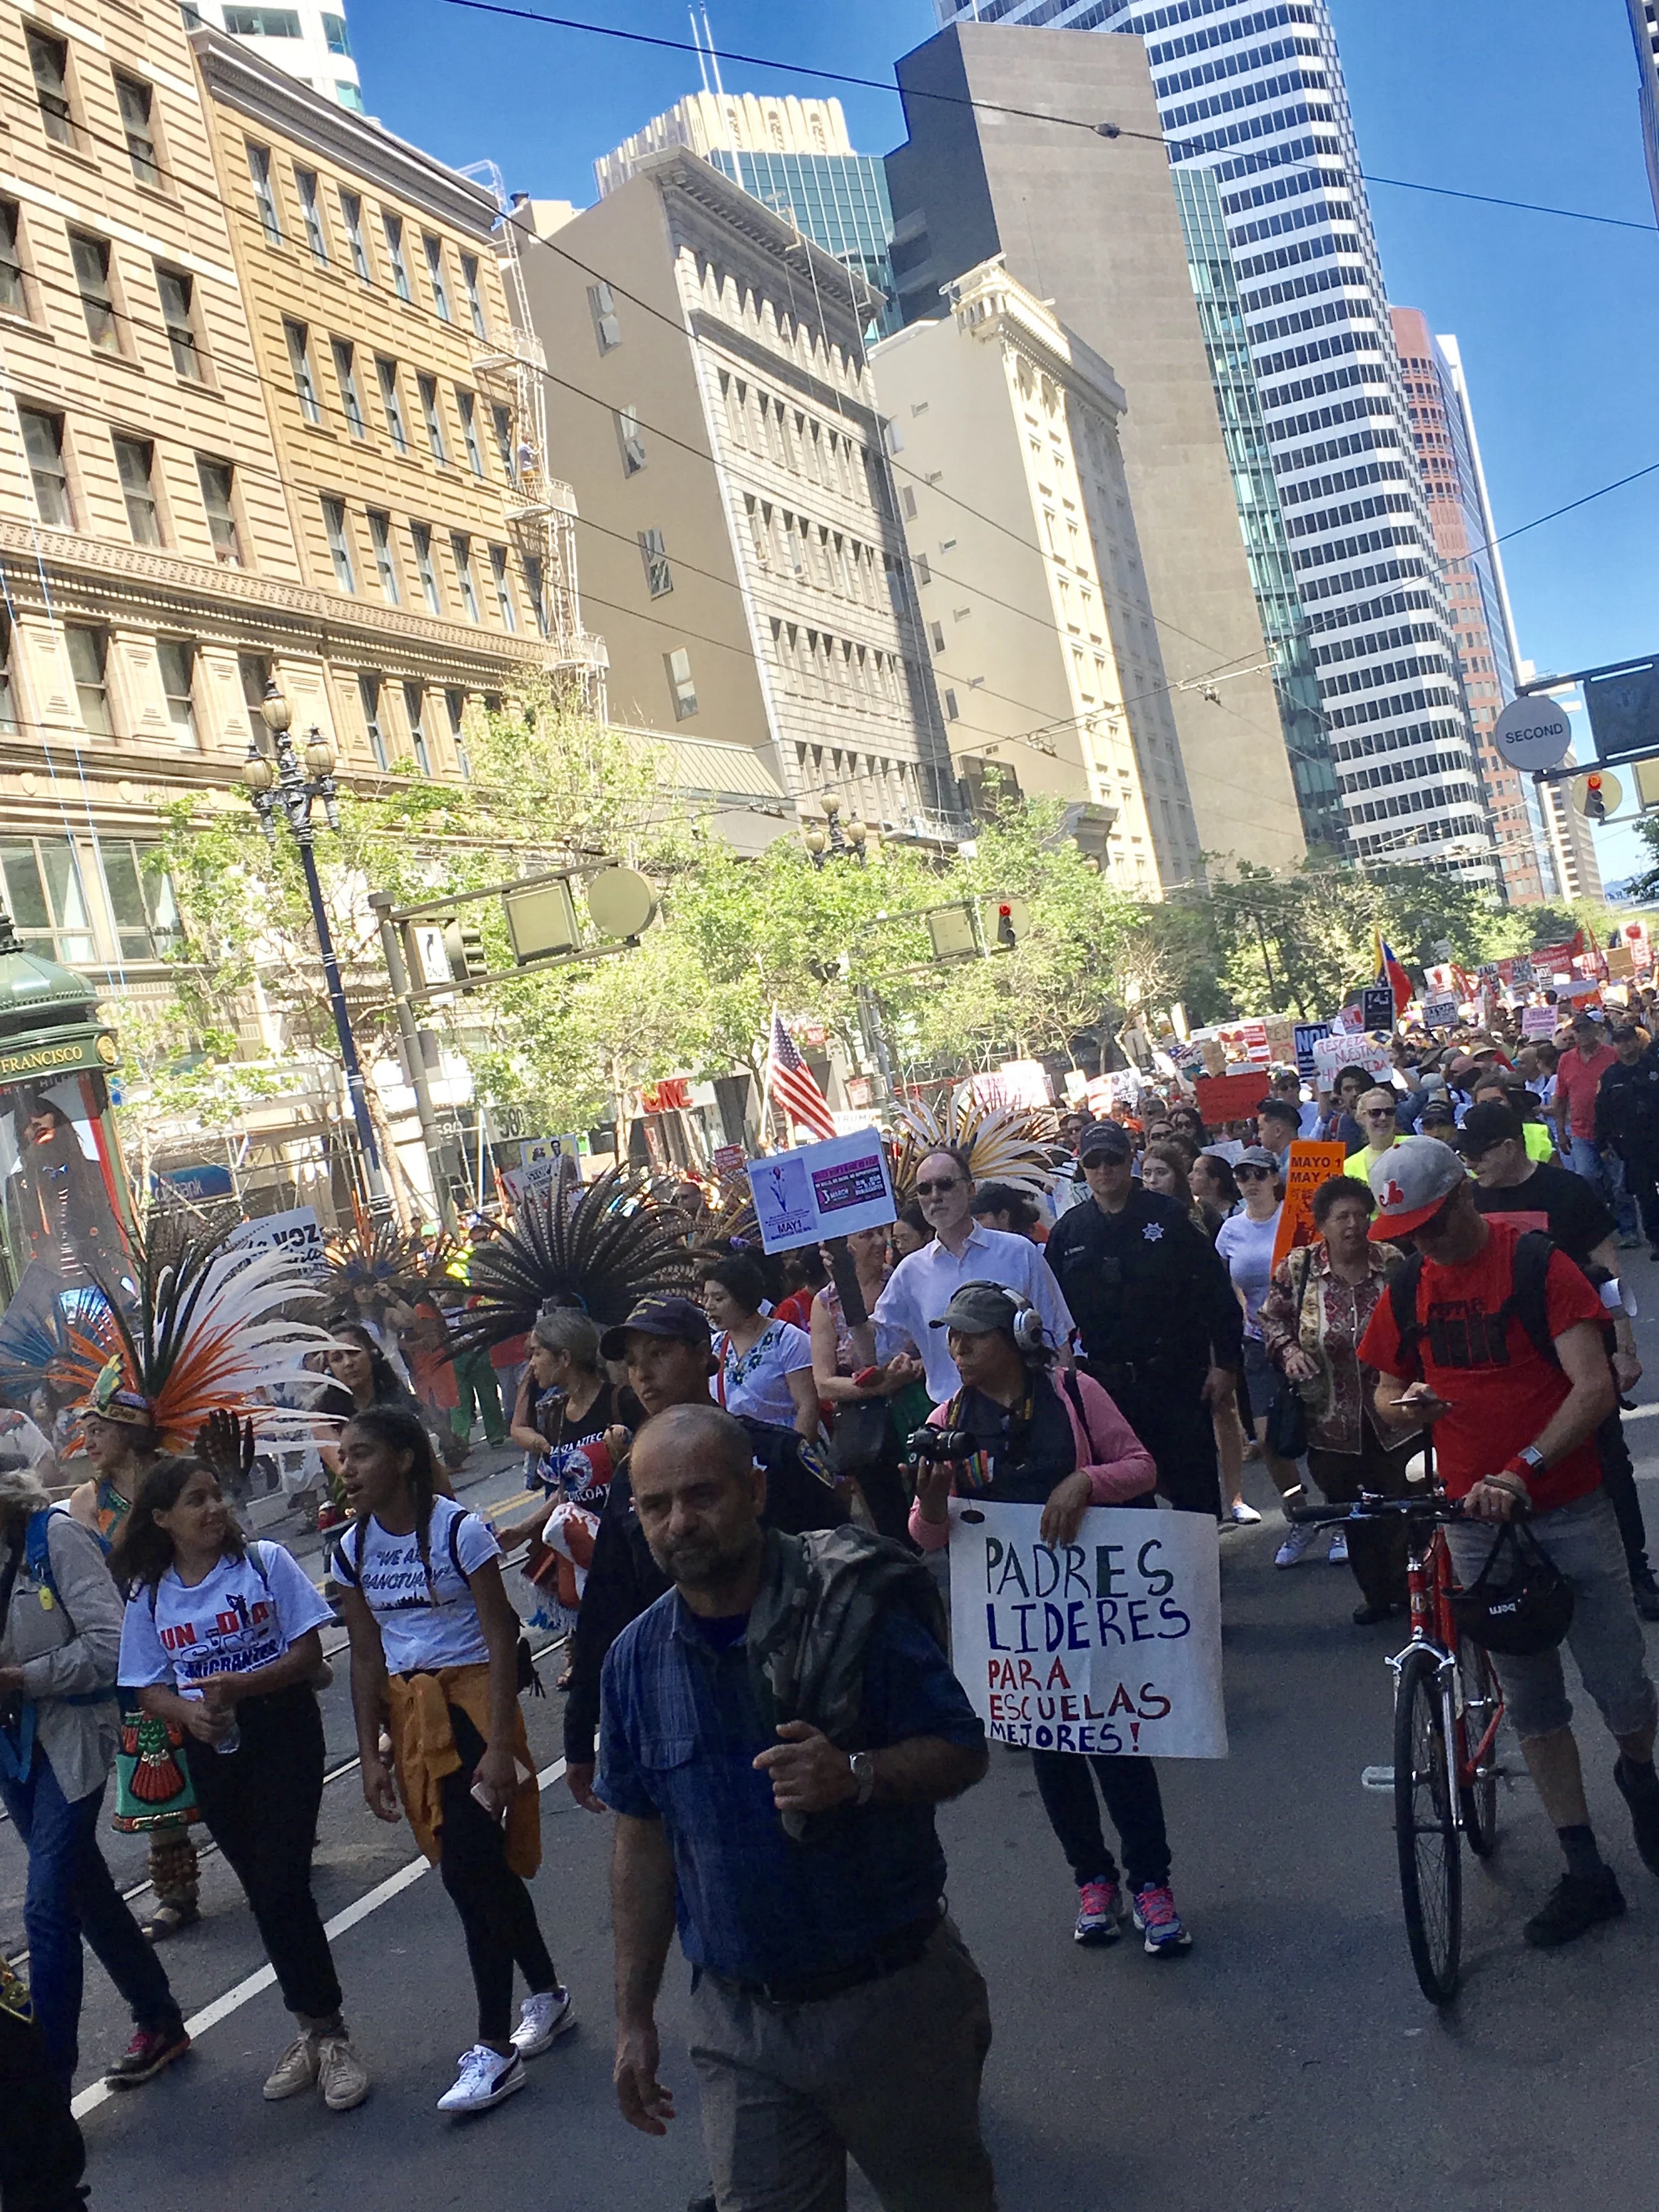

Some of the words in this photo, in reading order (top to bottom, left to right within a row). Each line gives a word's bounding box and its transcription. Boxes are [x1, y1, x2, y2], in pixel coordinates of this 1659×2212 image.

[1505, 723, 1563, 744] SECOND
[1317, 1035, 1368, 1055] RESPETA
[1, 1046, 83, 1074] FRANCISCO
[1290, 1157, 1331, 1169] MAYO
[1334, 1159, 1342, 1169] 1
[1289, 1172, 1321, 1183] MAY
[985, 1536, 1174, 1599] PADRES
[160, 1622, 196, 1651] UN
[986, 1597, 1190, 1653] LIDERES
[988, 1656, 1071, 1692] PARA
[989, 1682, 1172, 1723] ESCUELAS
